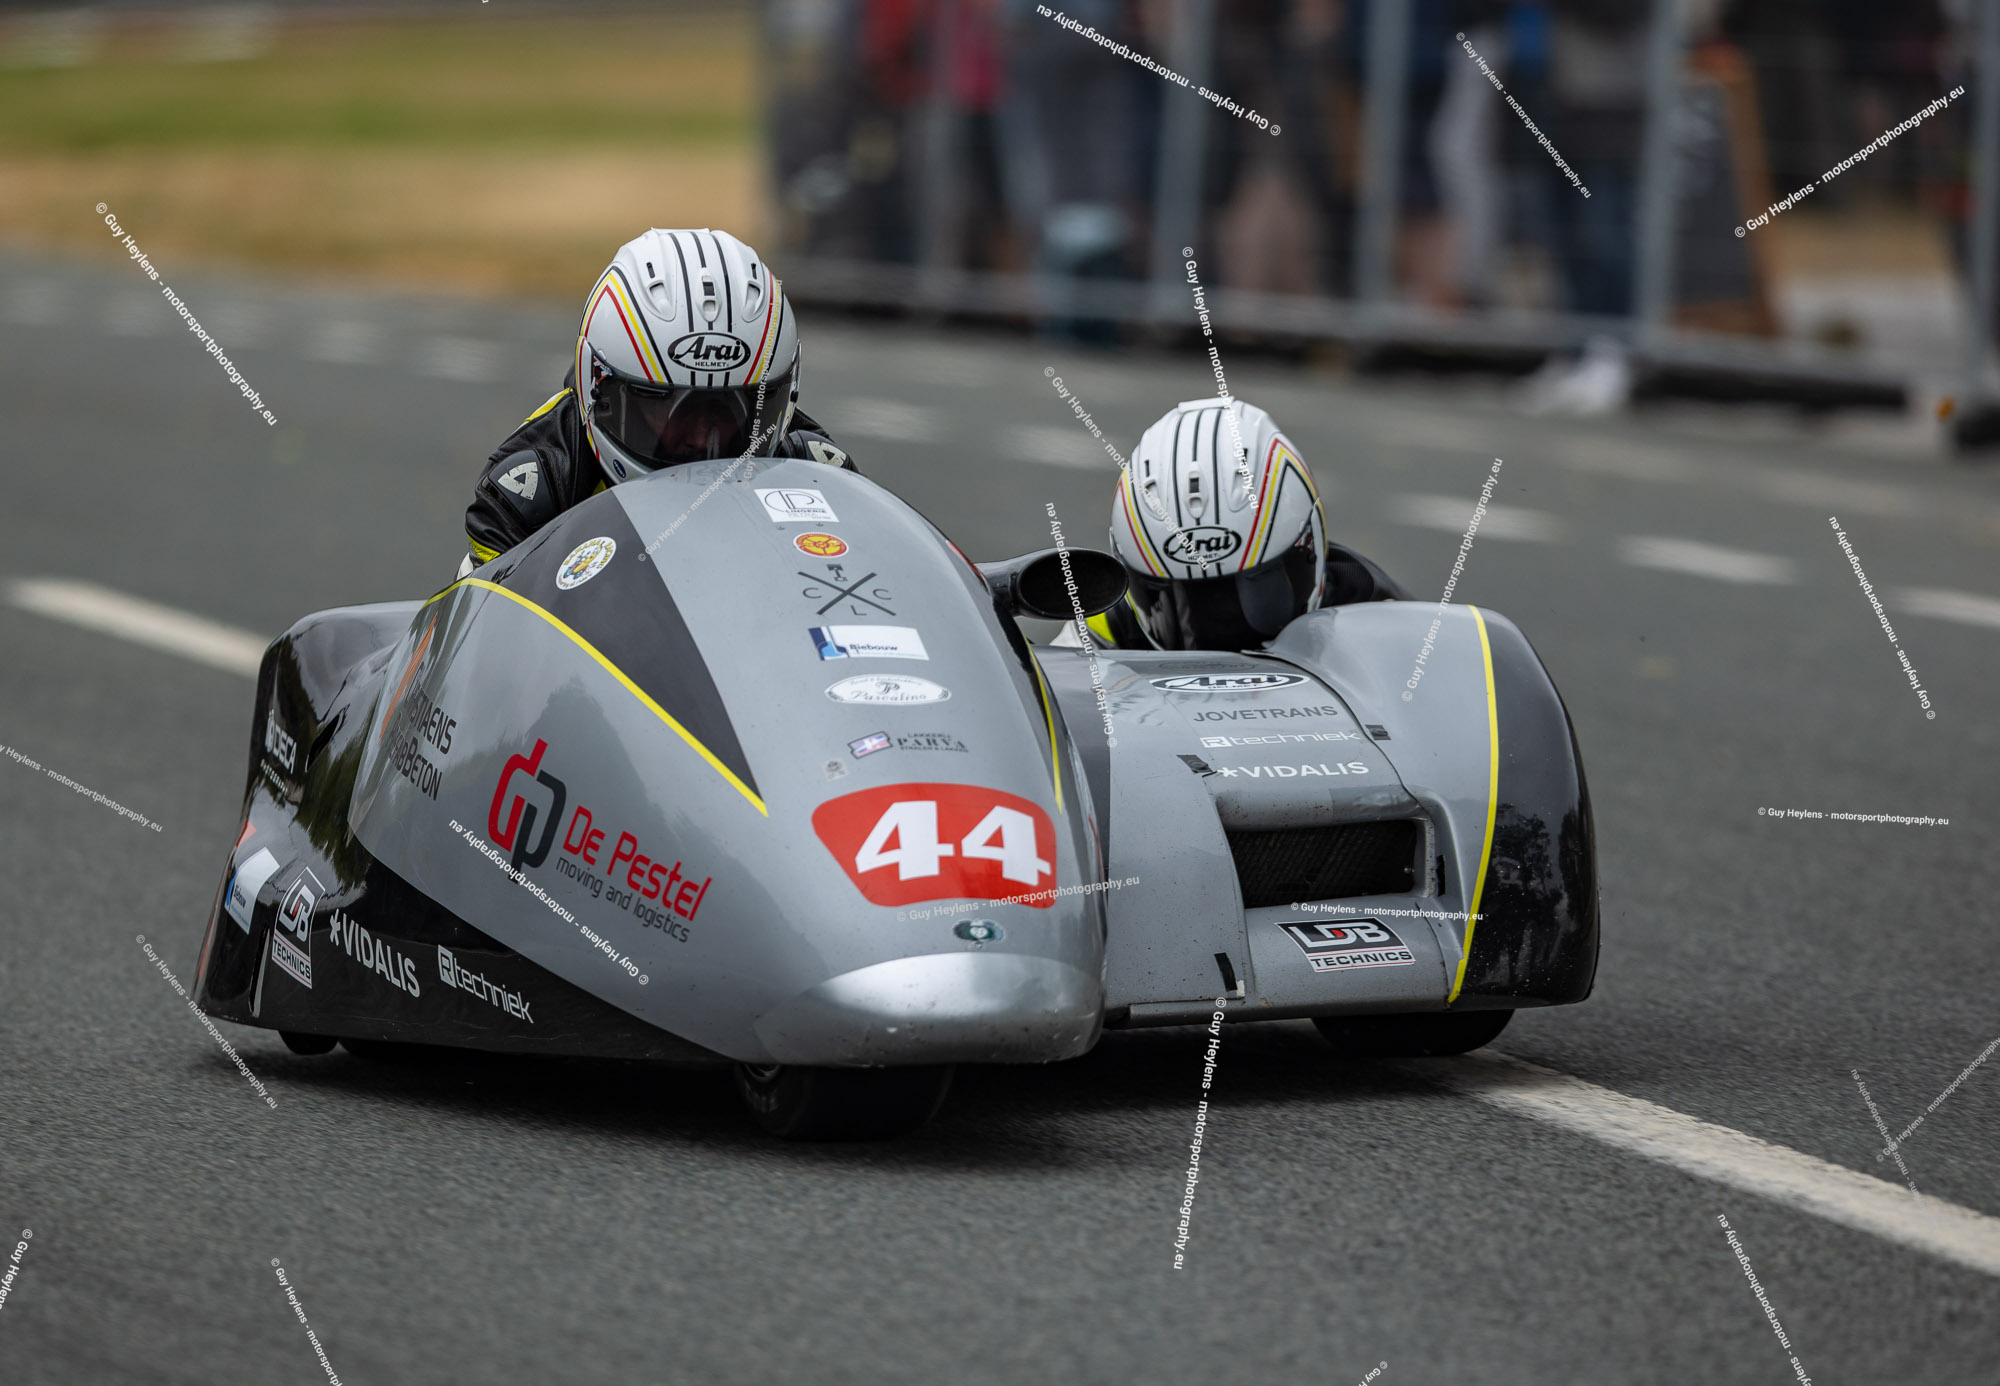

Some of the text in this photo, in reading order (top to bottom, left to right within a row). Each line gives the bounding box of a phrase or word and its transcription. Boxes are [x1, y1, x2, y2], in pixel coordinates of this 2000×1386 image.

[672, 336, 743, 361] Arai
[1168, 530, 1235, 556] Arai
[1164, 674, 1281, 689] Arai
[1193, 705, 1339, 722] JOVETRANS
[1239, 761, 1370, 778] VIDALIS
[854, 800, 1052, 887] 44
[562, 804, 713, 922] De Pestel
[555, 856, 691, 944] moving and logistics
[273, 939, 312, 980] TECHNICS
[342, 912, 421, 998] VIDALIS
[1310, 950, 1413, 968] TECHNICS
